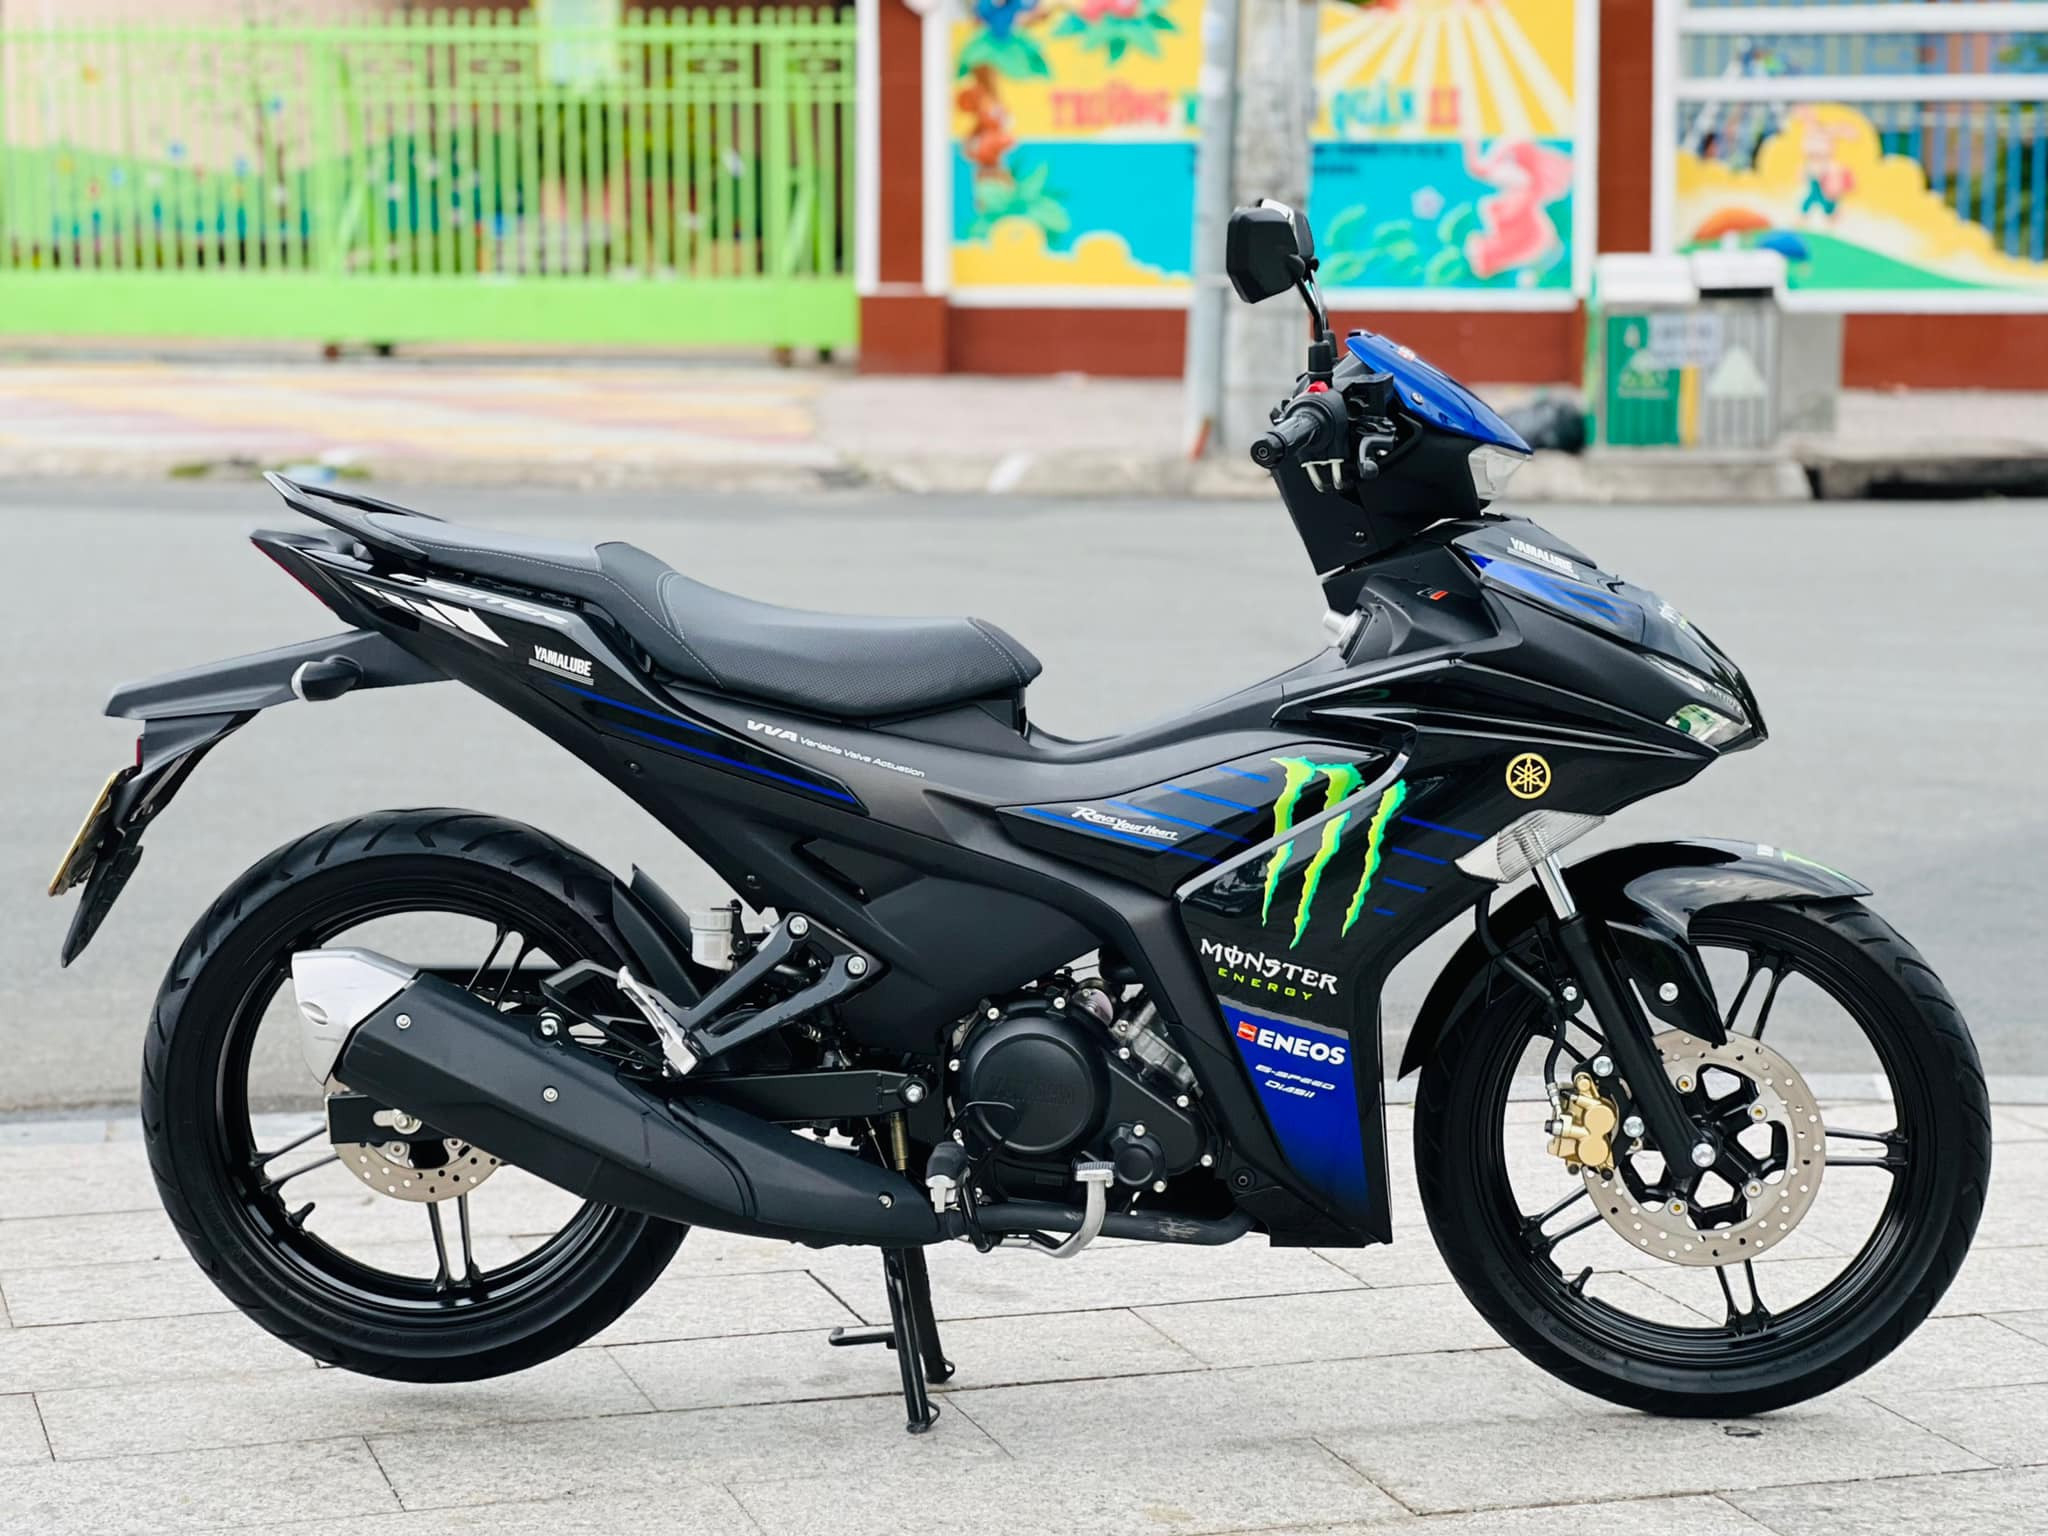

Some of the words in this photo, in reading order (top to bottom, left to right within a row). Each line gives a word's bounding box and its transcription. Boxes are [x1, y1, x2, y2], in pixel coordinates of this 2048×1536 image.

[534, 645, 592, 677] YAMALUBE
[747, 720, 797, 742] VVA
[800, 736, 843, 756] Variable
[844, 749, 871, 763] Valve
[873, 757, 925, 778] Actuation
[1072, 806, 1117, 826] Revs
[1112, 818, 1145, 833] Your
[1143, 825, 1178, 838] Heart
[1200, 938, 1338, 995] MONSTER
[1217, 967, 1313, 1001] ENERGY
[1257, 1028, 1346, 1066] ENEOS
